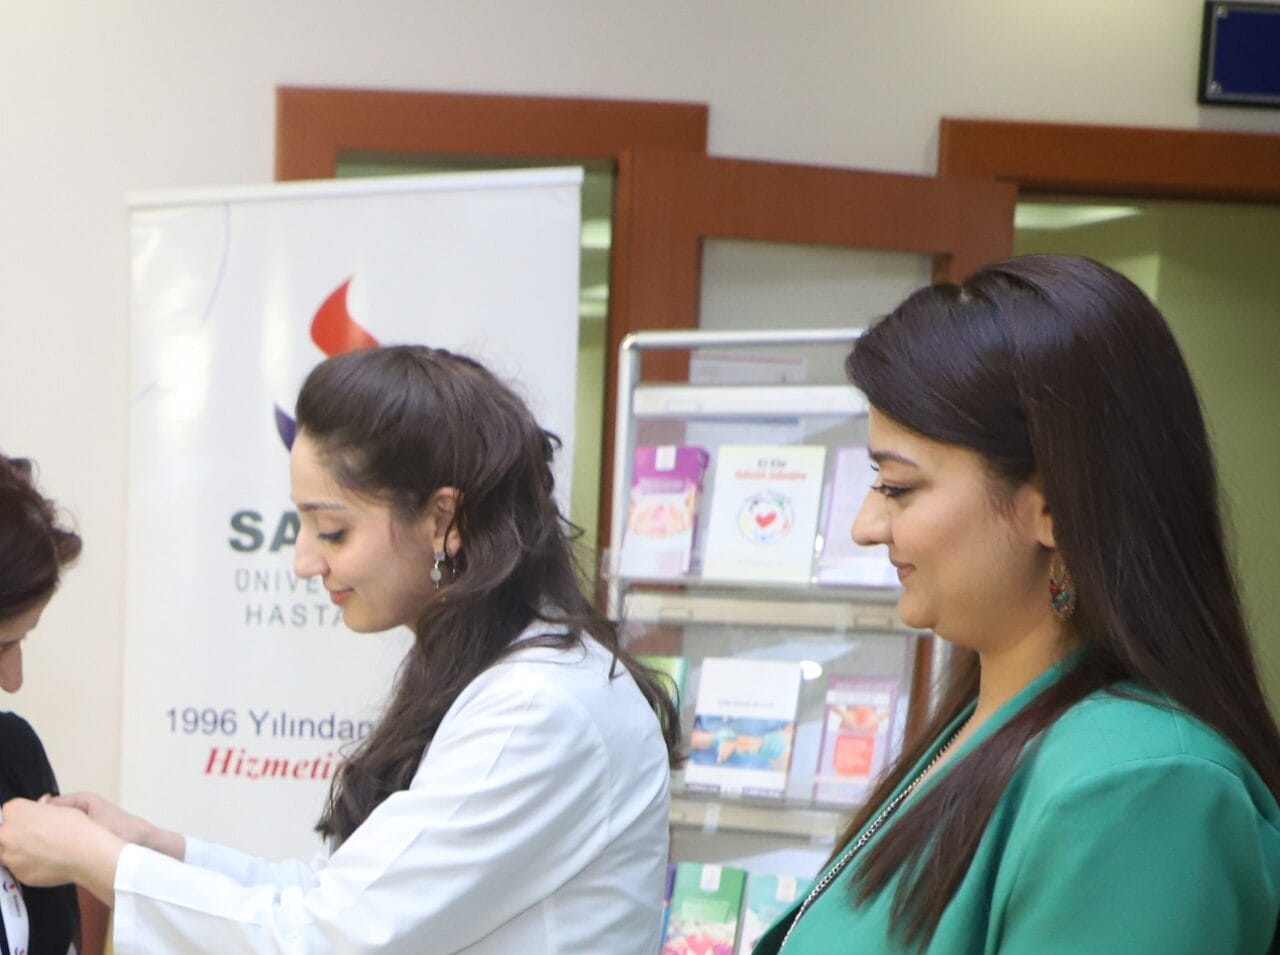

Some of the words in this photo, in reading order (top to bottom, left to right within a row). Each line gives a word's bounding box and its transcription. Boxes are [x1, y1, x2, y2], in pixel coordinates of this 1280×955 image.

[228, 509, 302, 553] SA
[167, 706, 239, 736] 1996
[204, 746, 342, 780] Hizmeti
